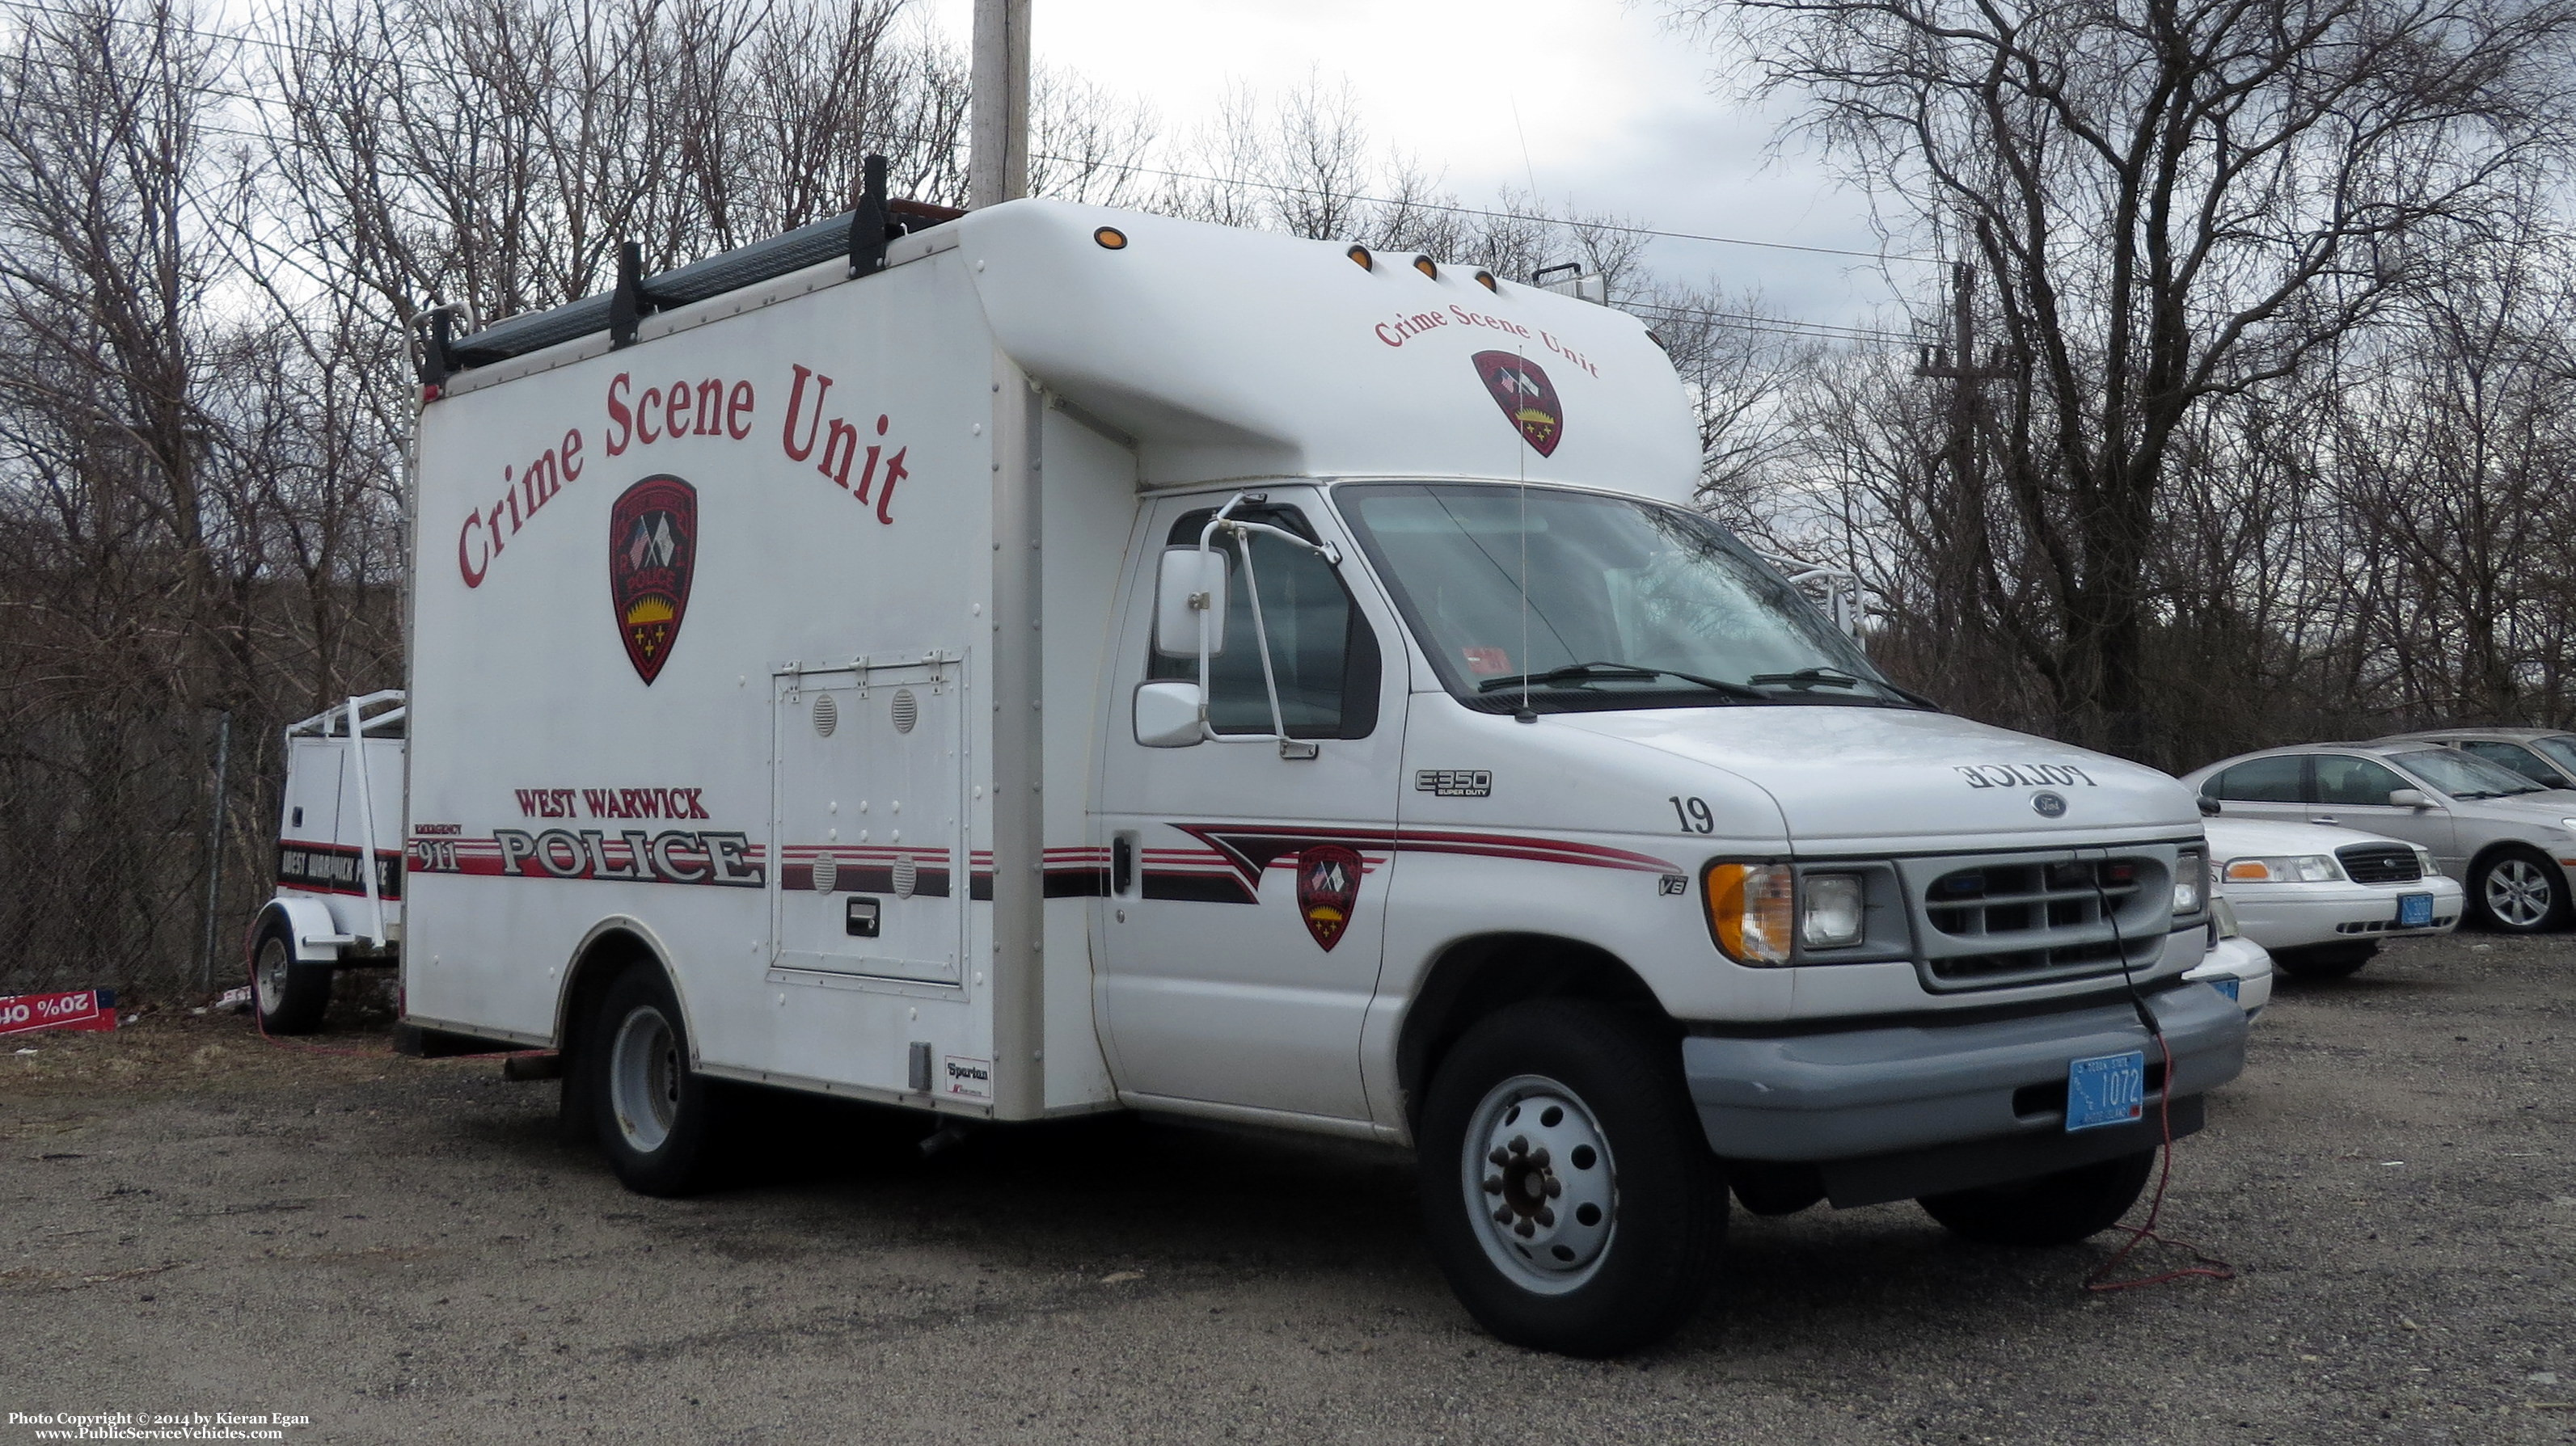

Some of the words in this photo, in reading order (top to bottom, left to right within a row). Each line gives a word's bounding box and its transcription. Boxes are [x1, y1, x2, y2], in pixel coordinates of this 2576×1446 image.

[1375, 308, 1448, 348] Crime
[1448, 304, 1531, 339] Scene
[1539, 328, 1599, 379] Unit
[458, 427, 583, 588] Crime
[606, 371, 754, 457] Scene
[783, 363, 909, 525] Unit
[515, 788, 576, 817] WEST
[582, 788, 710, 819] WARWICK
[1669, 796, 1714, 834] 19
[2041, 798, 2059, 811] Ford
[283, 850, 306, 875] WEST
[308, 854, 354, 882] WARWICK
[417, 840, 461, 871] 911
[492, 828, 766, 888] POLICE
[1659, 879, 1685, 896] V8
[37, 993, 88, 1018] 20%
[948, 1063, 988, 1080] Spartan
[2102, 1068, 2139, 1108] 1072
